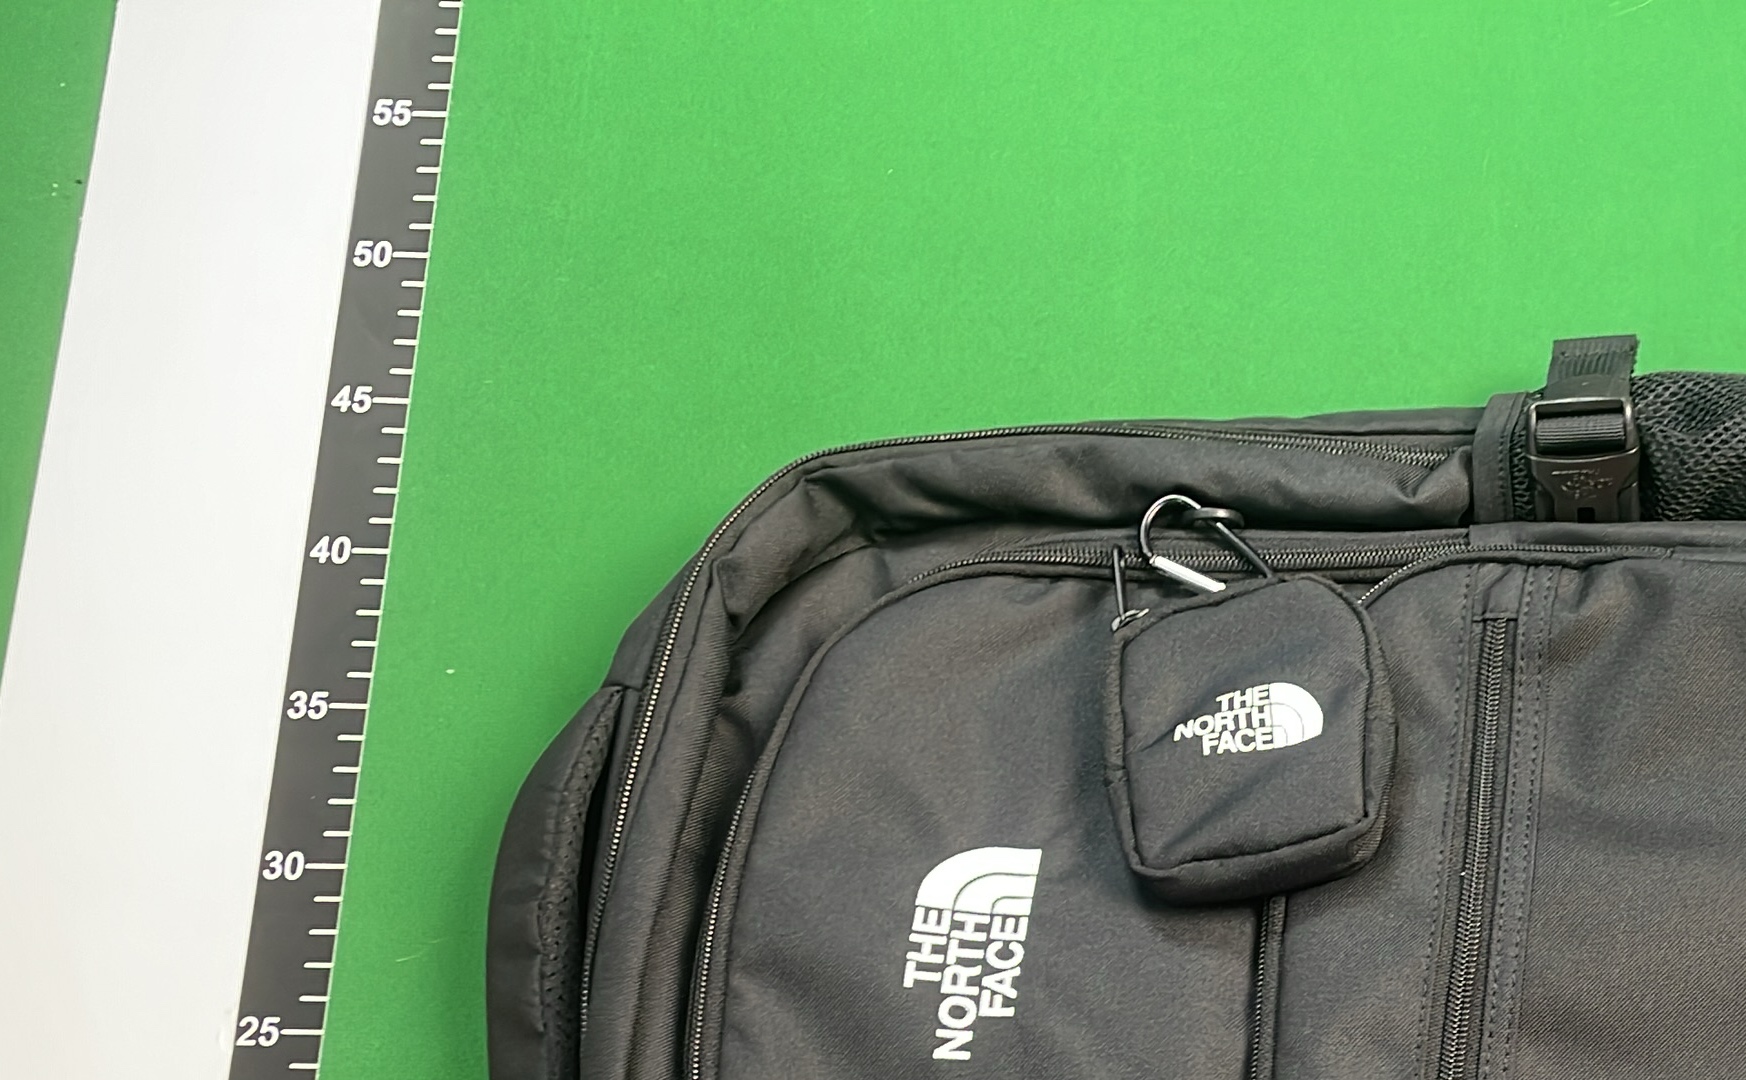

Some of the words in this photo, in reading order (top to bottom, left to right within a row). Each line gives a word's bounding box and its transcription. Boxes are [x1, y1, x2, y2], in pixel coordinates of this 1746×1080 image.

[372, 99, 412, 126] 55
[352, 241, 393, 268] 50
[330, 385, 373, 413] 45
[309, 536, 352, 564] 40
[286, 690, 329, 720] 35
[1215, 684, 1270, 713] THE
[1173, 705, 1272, 742] NORTH
[1202, 727, 1274, 756] FACE
[262, 850, 305, 881] 30
[902, 906, 951, 988] THE
[977, 915, 1029, 1018] FACE
[931, 911, 992, 1061] NORTH
[234, 1016, 281, 1047] 25
